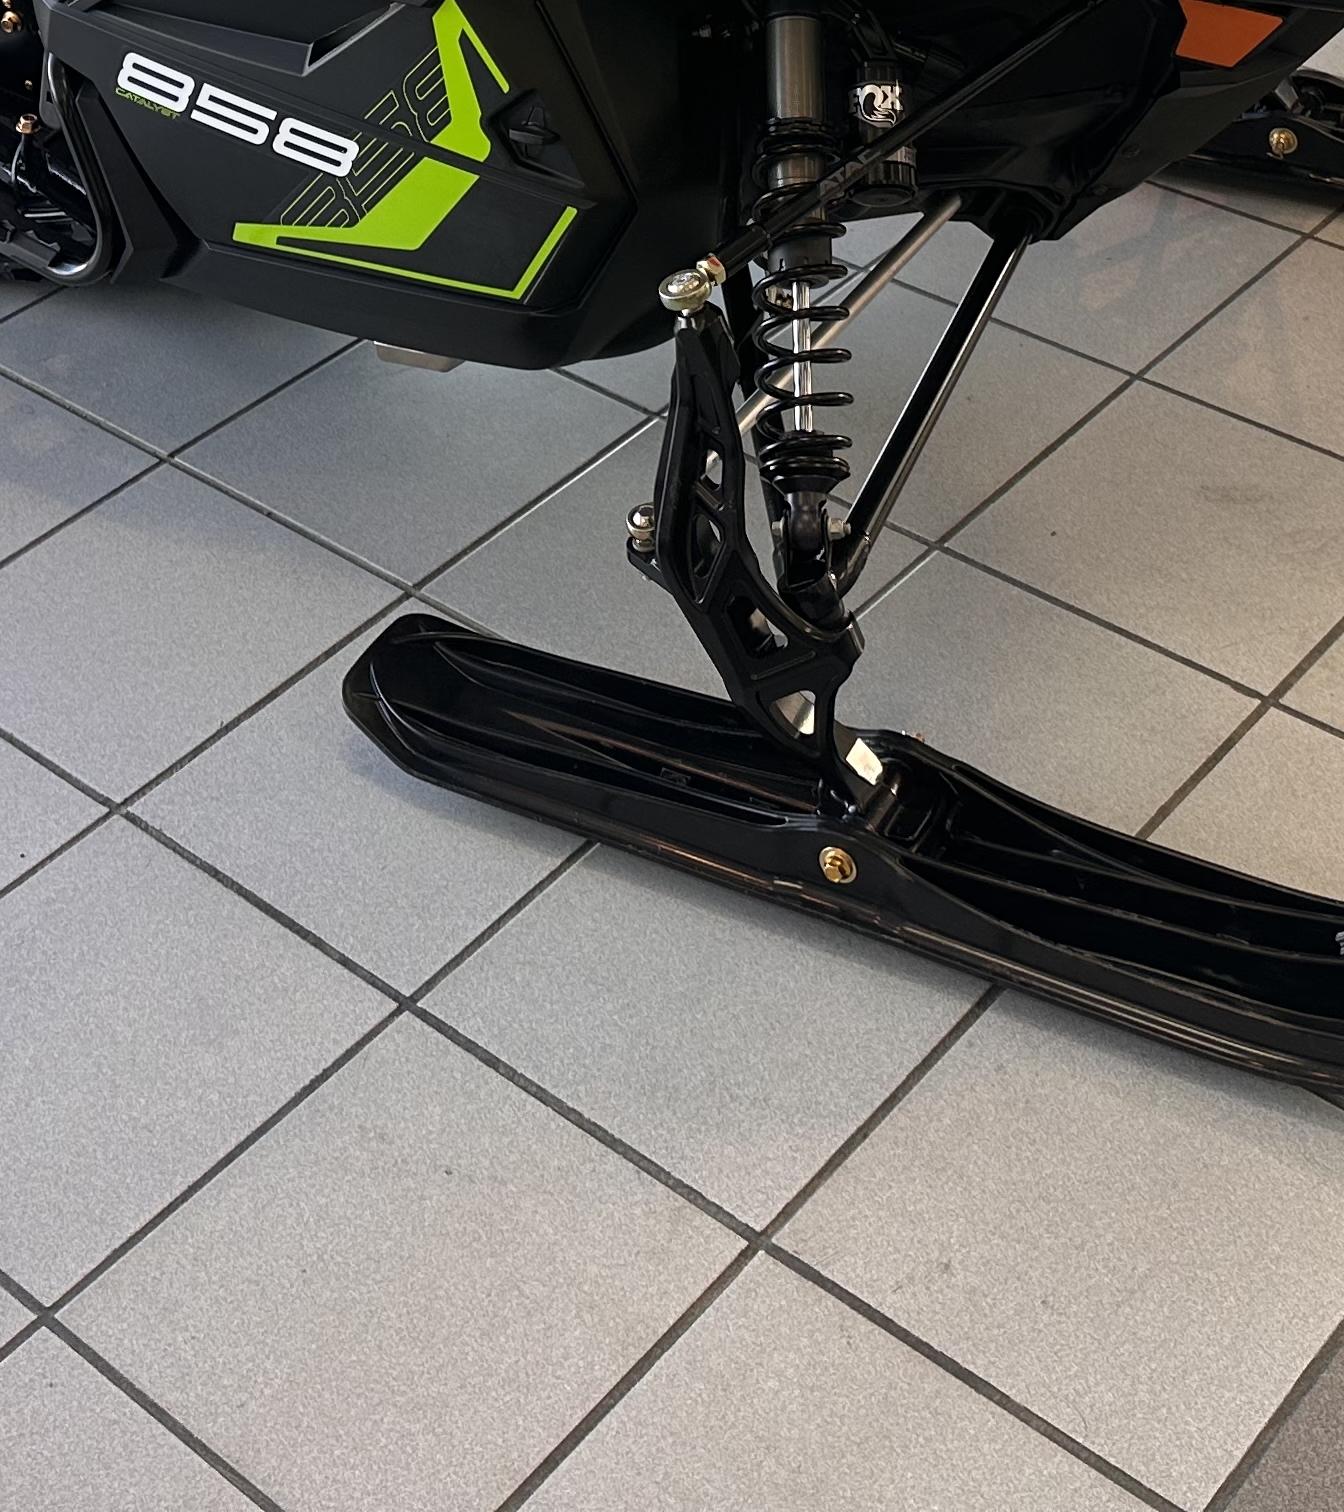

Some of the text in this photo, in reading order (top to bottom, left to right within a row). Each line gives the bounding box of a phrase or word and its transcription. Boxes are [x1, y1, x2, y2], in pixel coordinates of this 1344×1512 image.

[115, 87, 181, 120] CATALYST
[117, 52, 360, 178] 858
[849, 84, 903, 125] FOX
